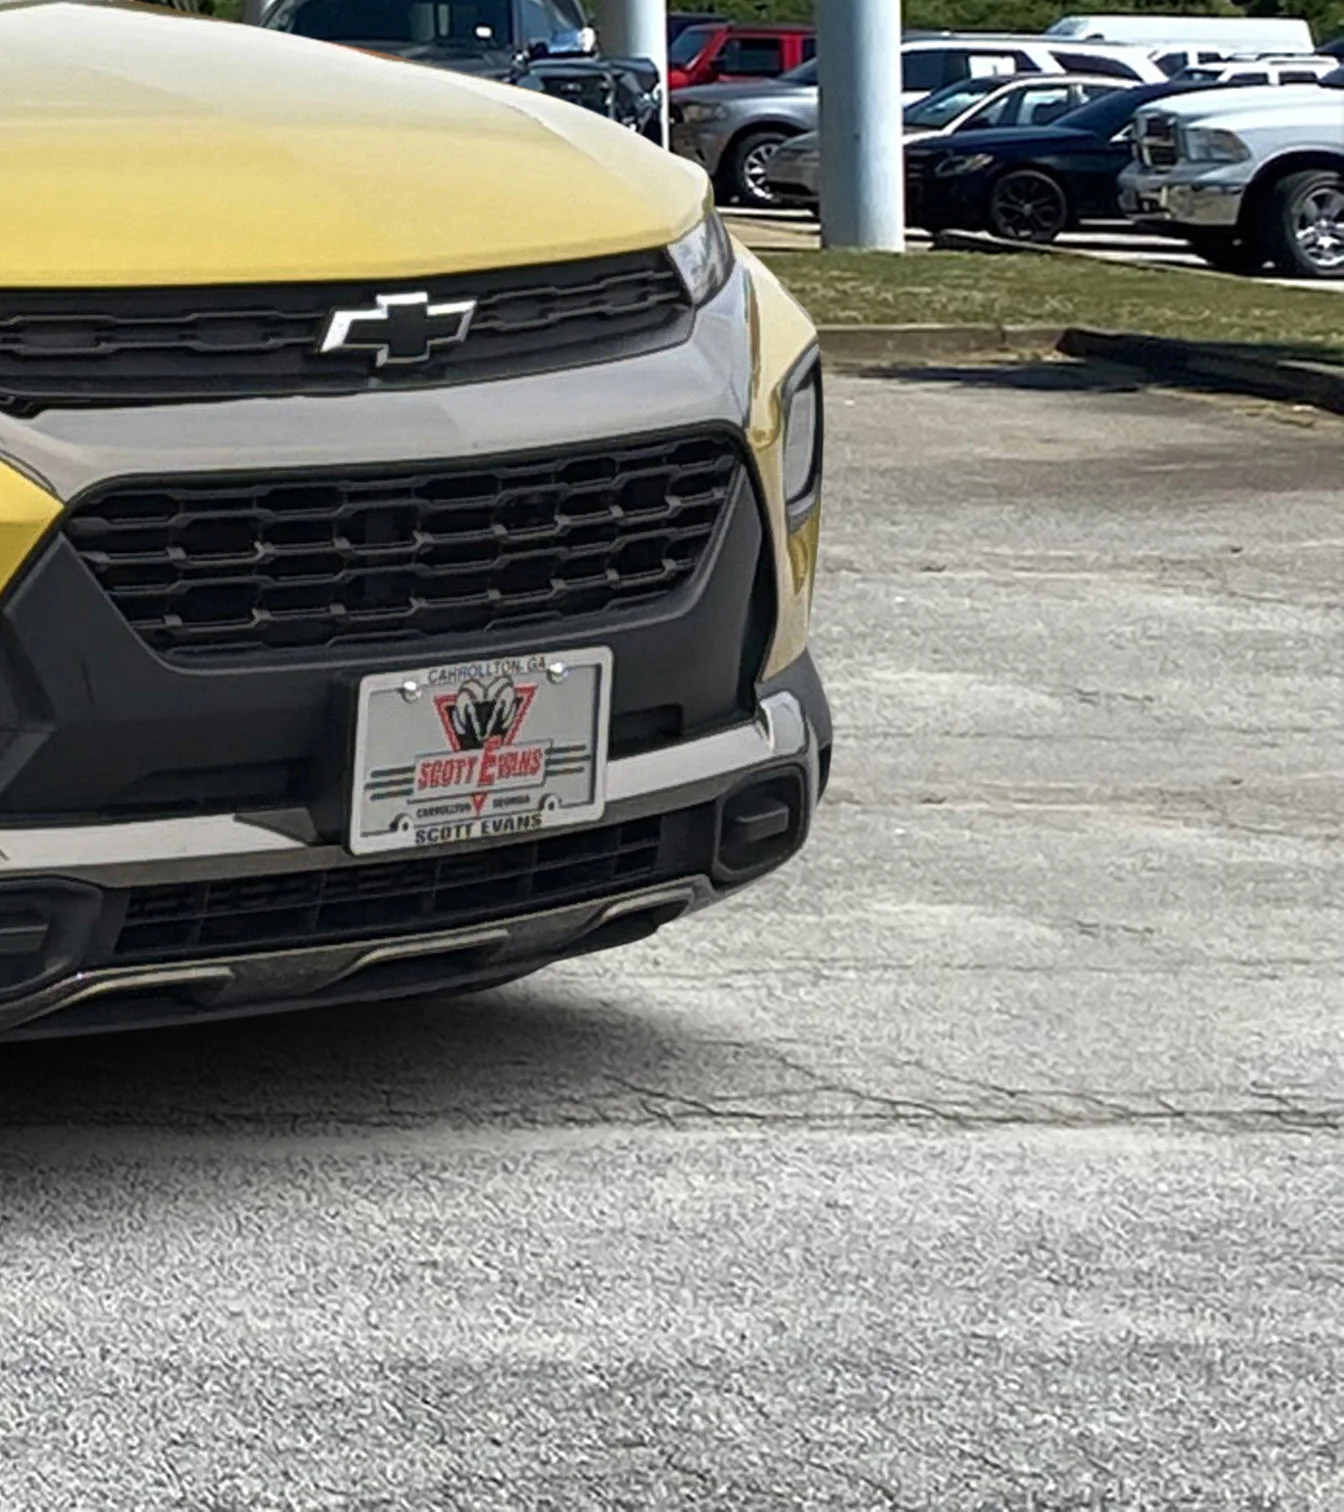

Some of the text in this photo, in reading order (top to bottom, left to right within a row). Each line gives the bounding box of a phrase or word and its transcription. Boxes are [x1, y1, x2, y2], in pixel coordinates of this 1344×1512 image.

[417, 754, 479, 790] SCOTT
[415, 813, 542, 845] SCOTT EVANS
